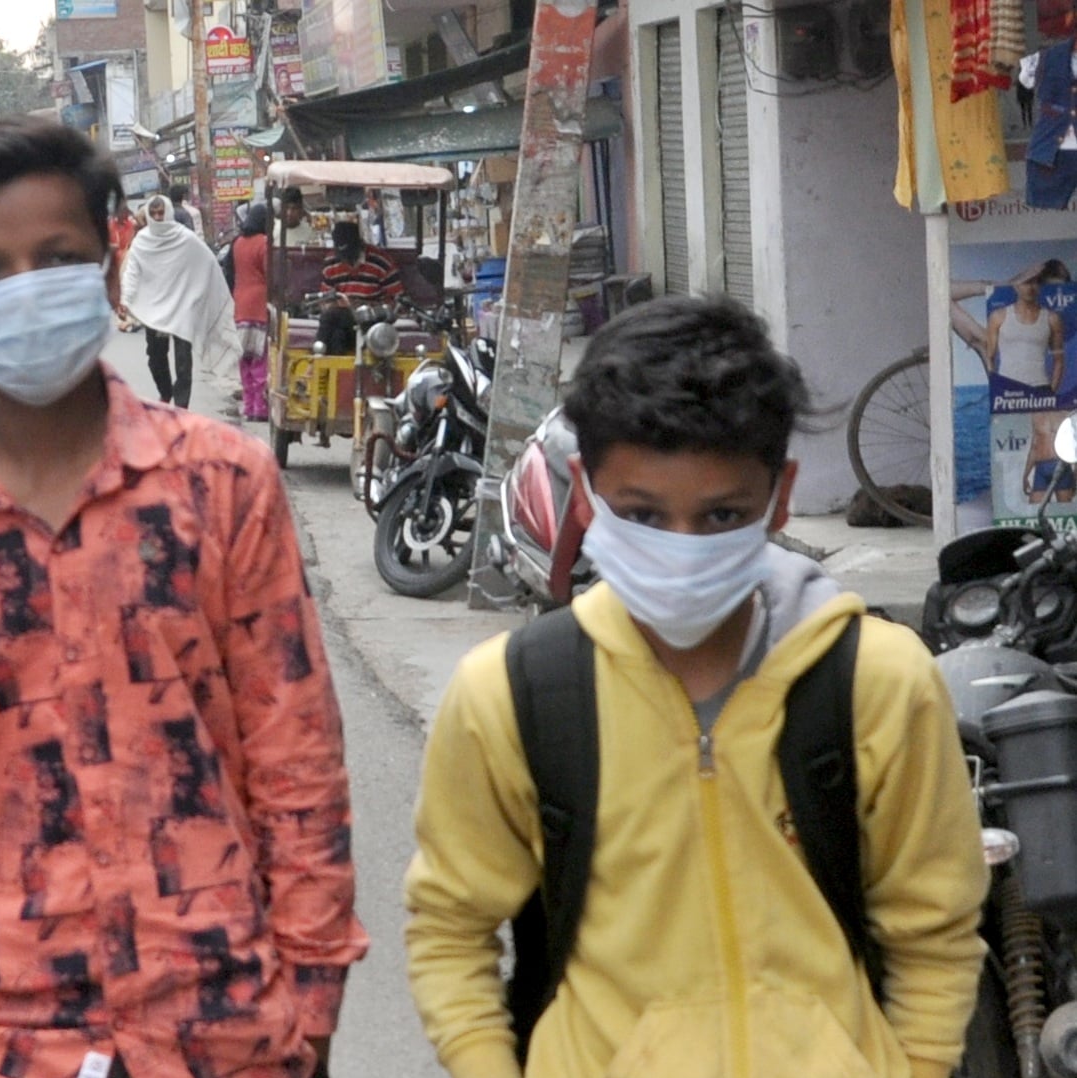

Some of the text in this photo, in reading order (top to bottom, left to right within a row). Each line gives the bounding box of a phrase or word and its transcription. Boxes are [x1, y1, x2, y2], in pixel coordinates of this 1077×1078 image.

[1045, 287, 1074, 308] VIP
[993, 393, 1057, 411] Premium
[996, 430, 1028, 451] VIP
